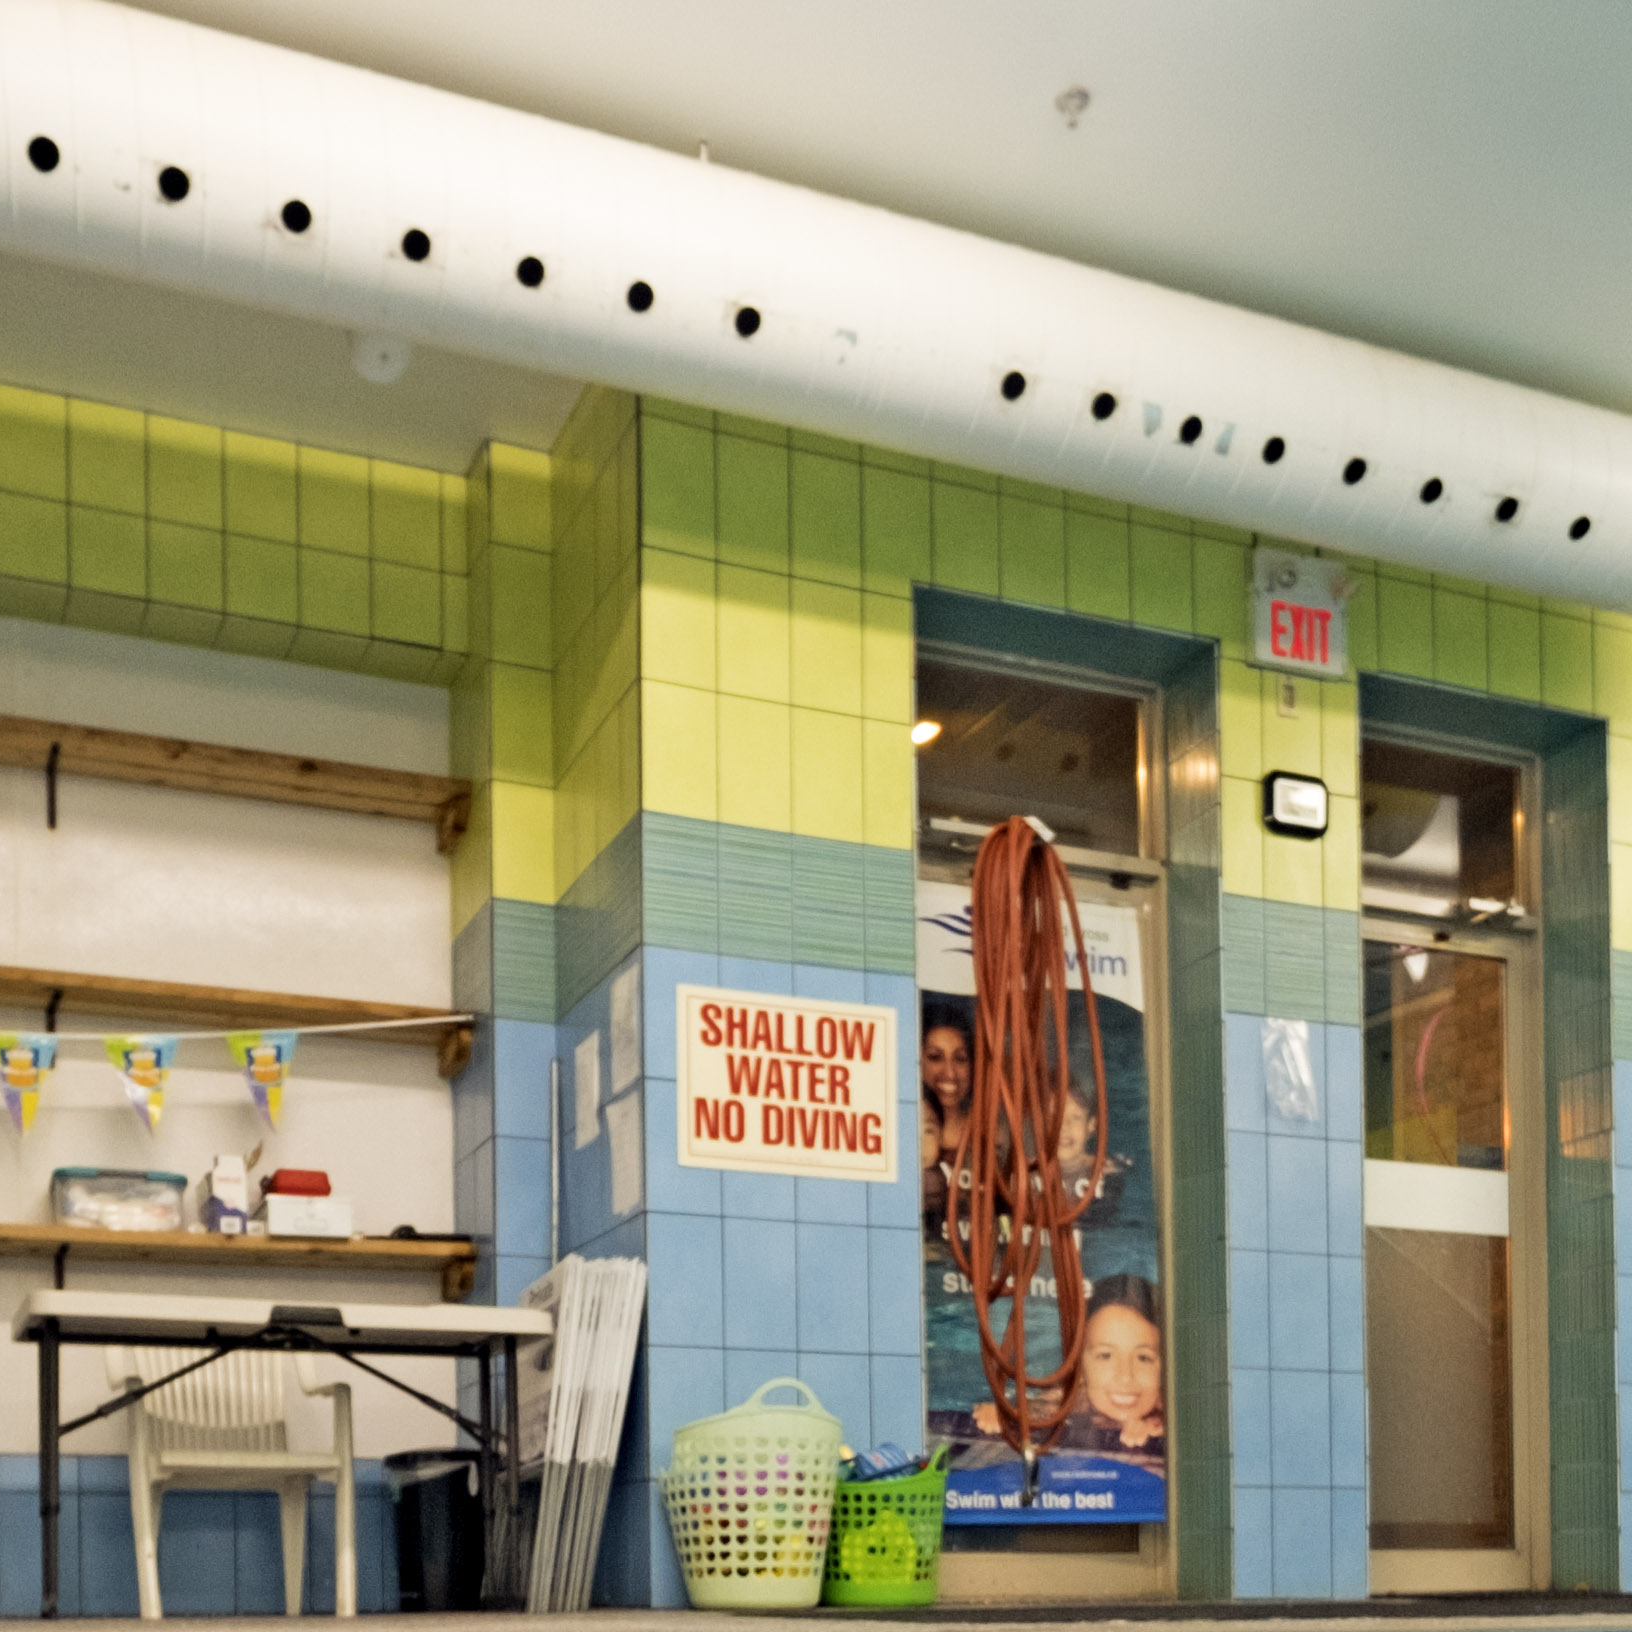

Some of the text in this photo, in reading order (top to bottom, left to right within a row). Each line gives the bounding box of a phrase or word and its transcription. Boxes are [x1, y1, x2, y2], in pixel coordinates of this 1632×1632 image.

[1271, 600, 1331, 664] EXIT
[1064, 945, 1127, 977] wim
[700, 1003, 875, 1062] SHALLOW
[726, 1053, 851, 1106] WATER
[694, 1097, 883, 1155] NO DIVING
[945, 1489, 1115, 1509] Swim wi the best
